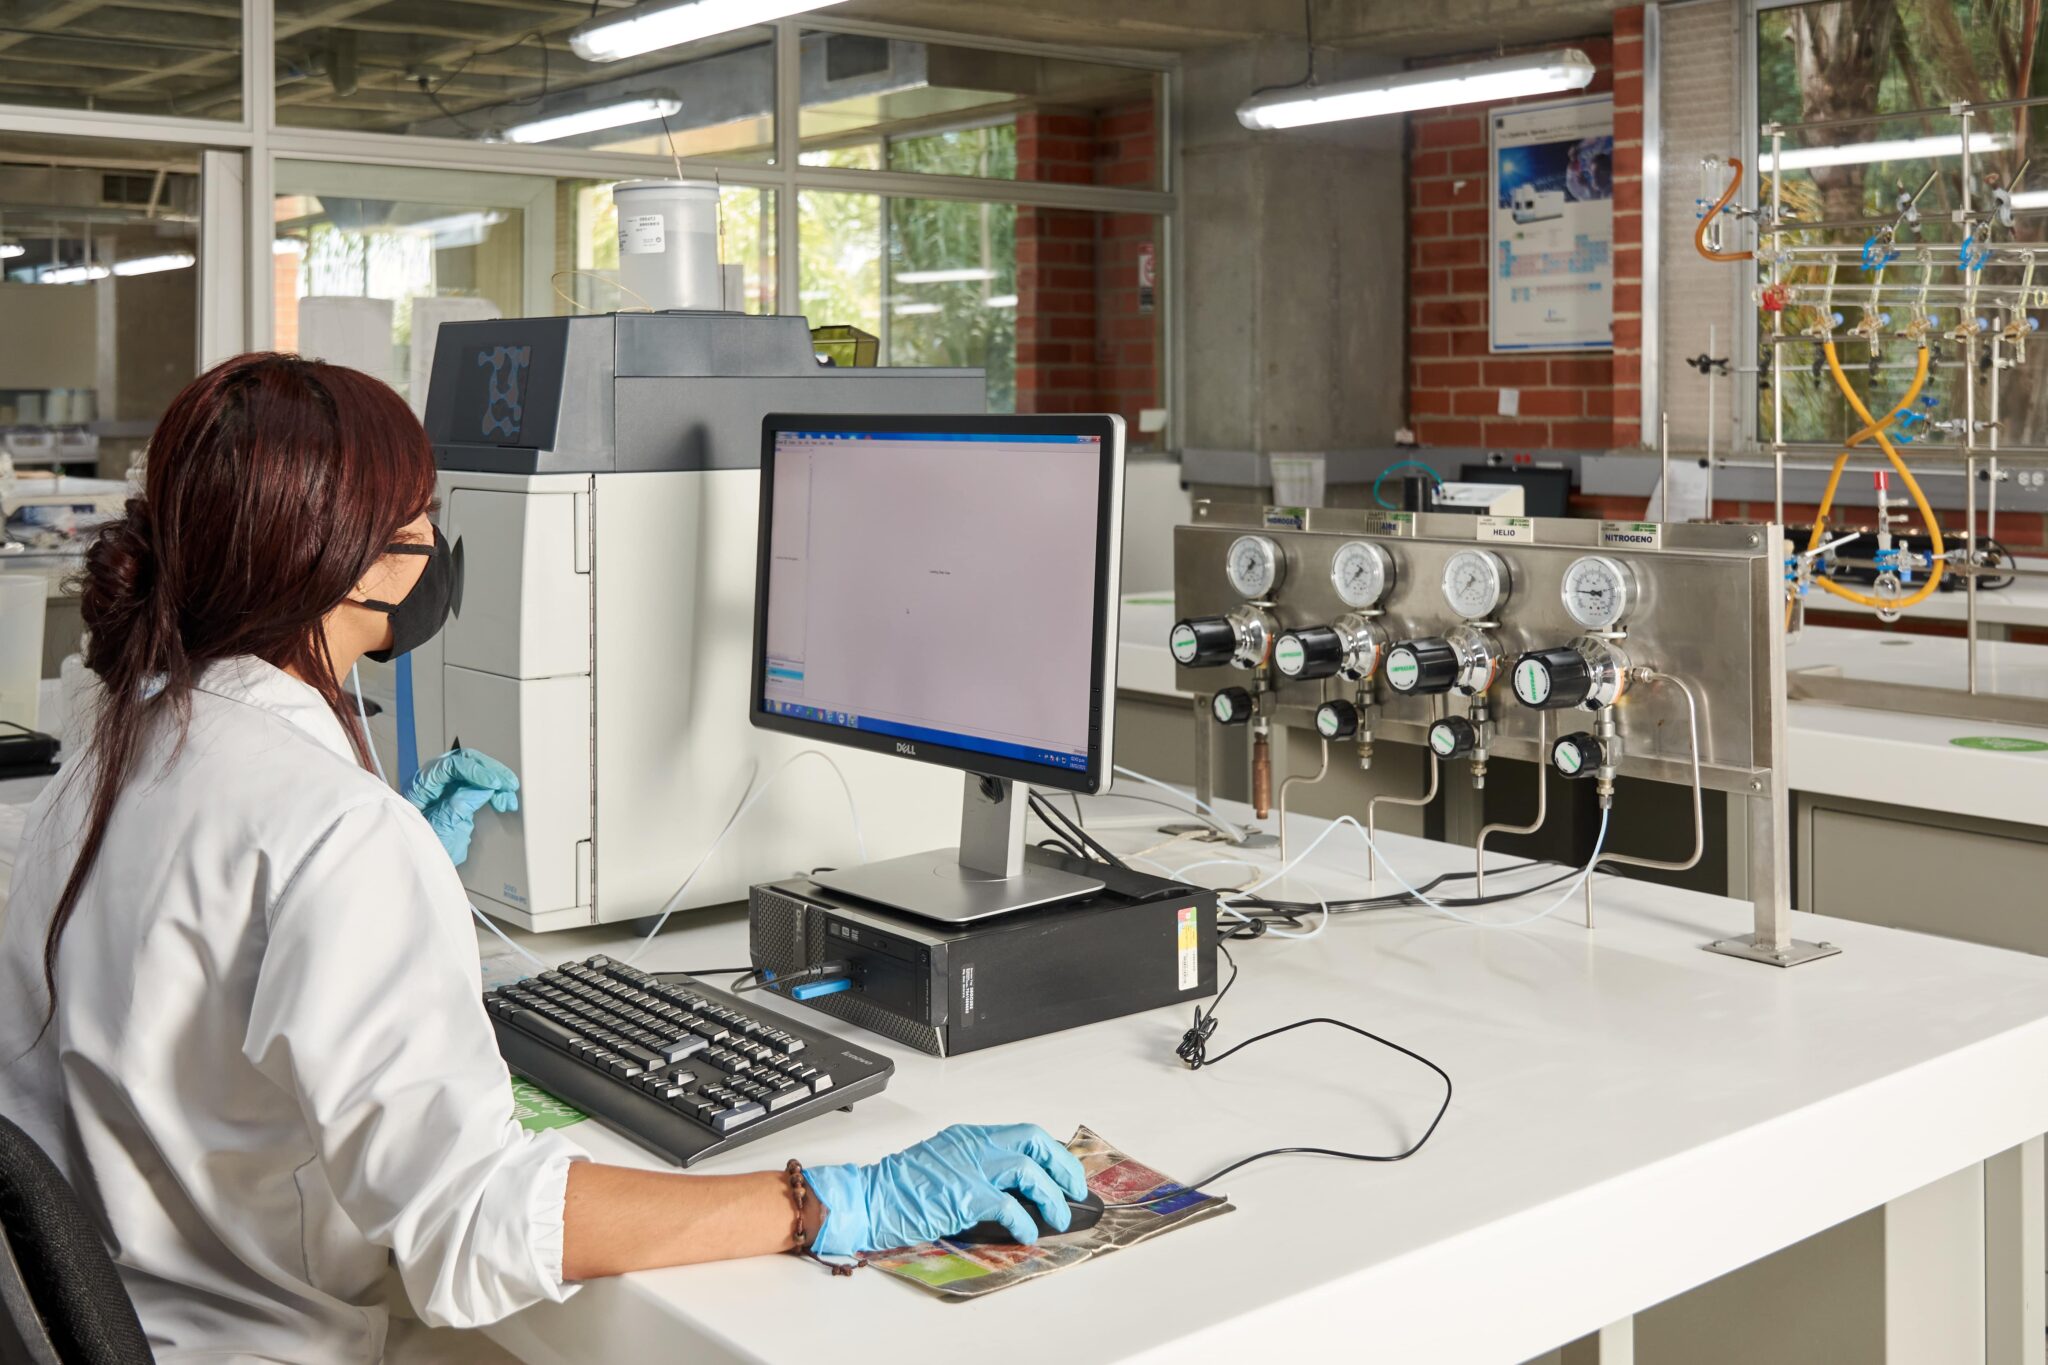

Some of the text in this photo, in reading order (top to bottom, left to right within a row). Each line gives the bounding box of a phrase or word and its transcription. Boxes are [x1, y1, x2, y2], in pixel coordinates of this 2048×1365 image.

[1380, 521, 1397, 531] AIRE
[1493, 528, 1515, 537] HELIO
[1605, 533, 1653, 543] NITROGENO
[896, 742, 916, 755] DELL
